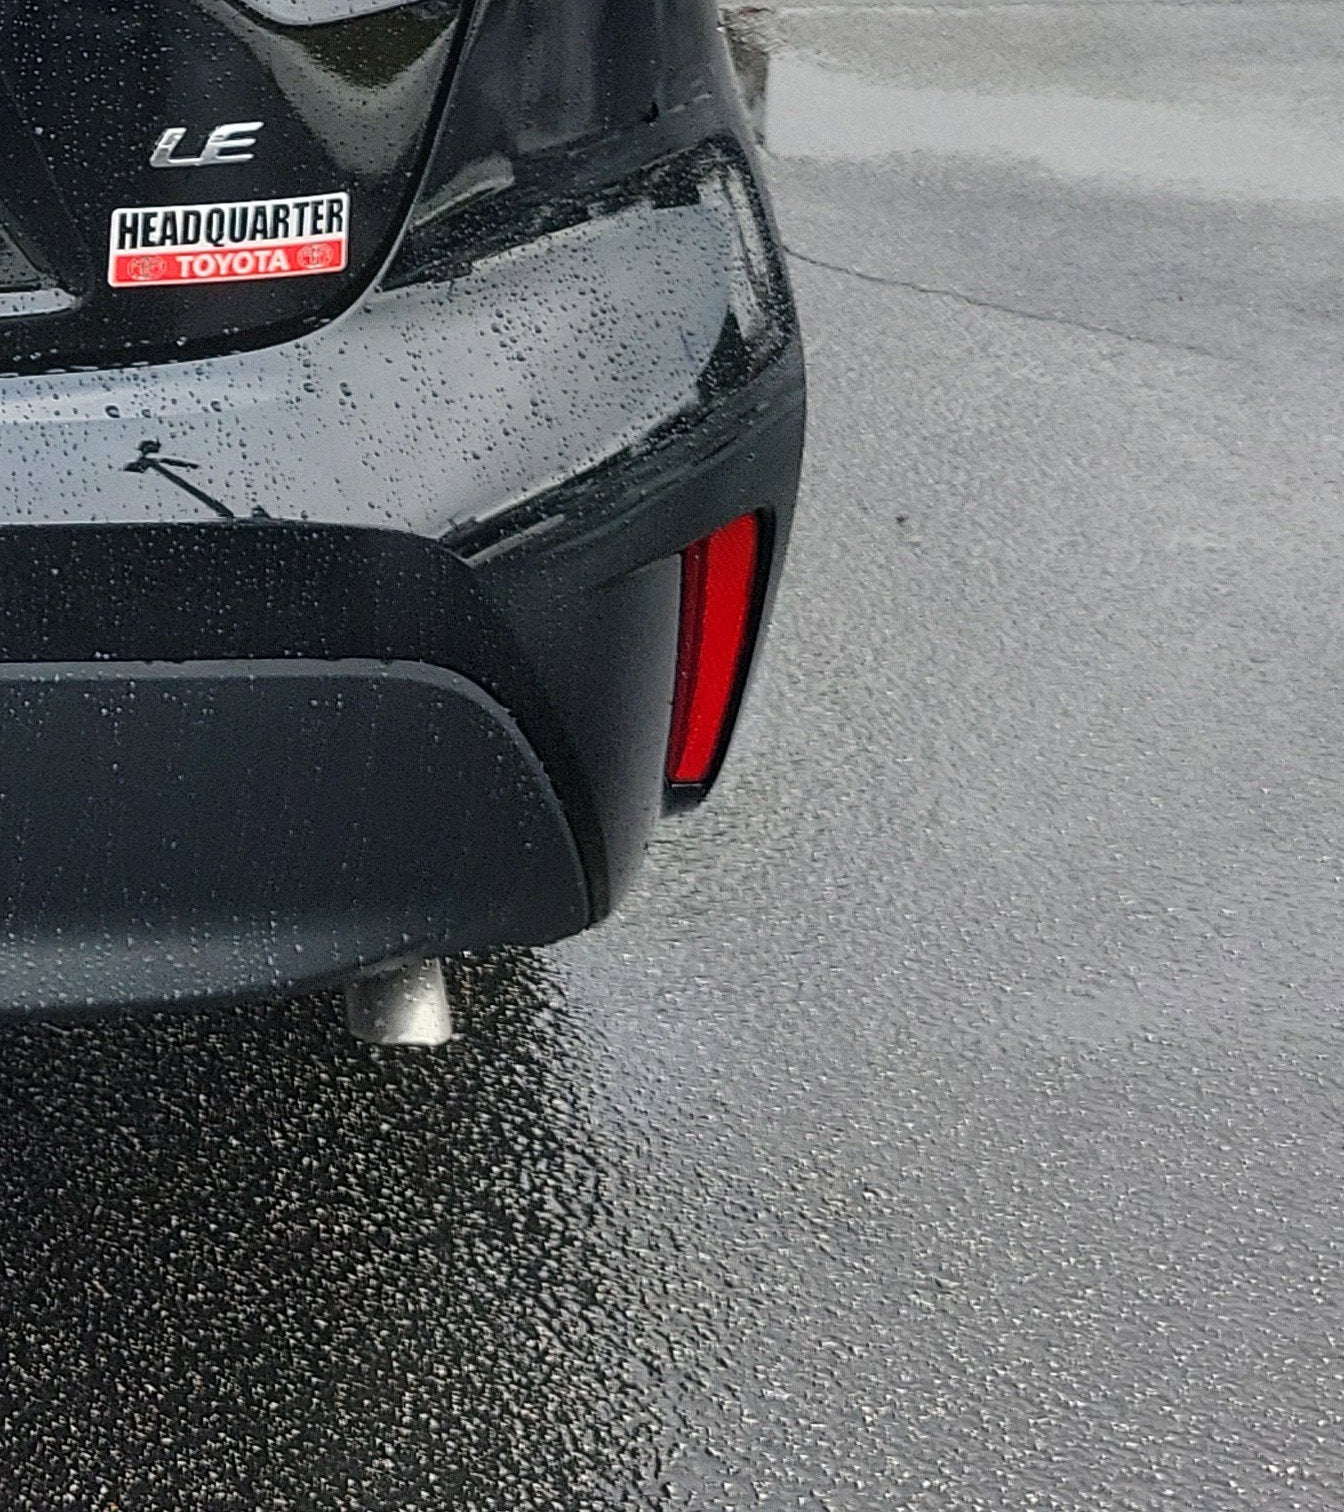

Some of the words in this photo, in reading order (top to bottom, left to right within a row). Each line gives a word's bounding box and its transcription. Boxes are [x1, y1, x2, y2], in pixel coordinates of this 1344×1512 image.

[149, 121, 265, 168] LE
[116, 197, 344, 250] HEADQUARTER
[175, 249, 290, 278] TOYOTA
